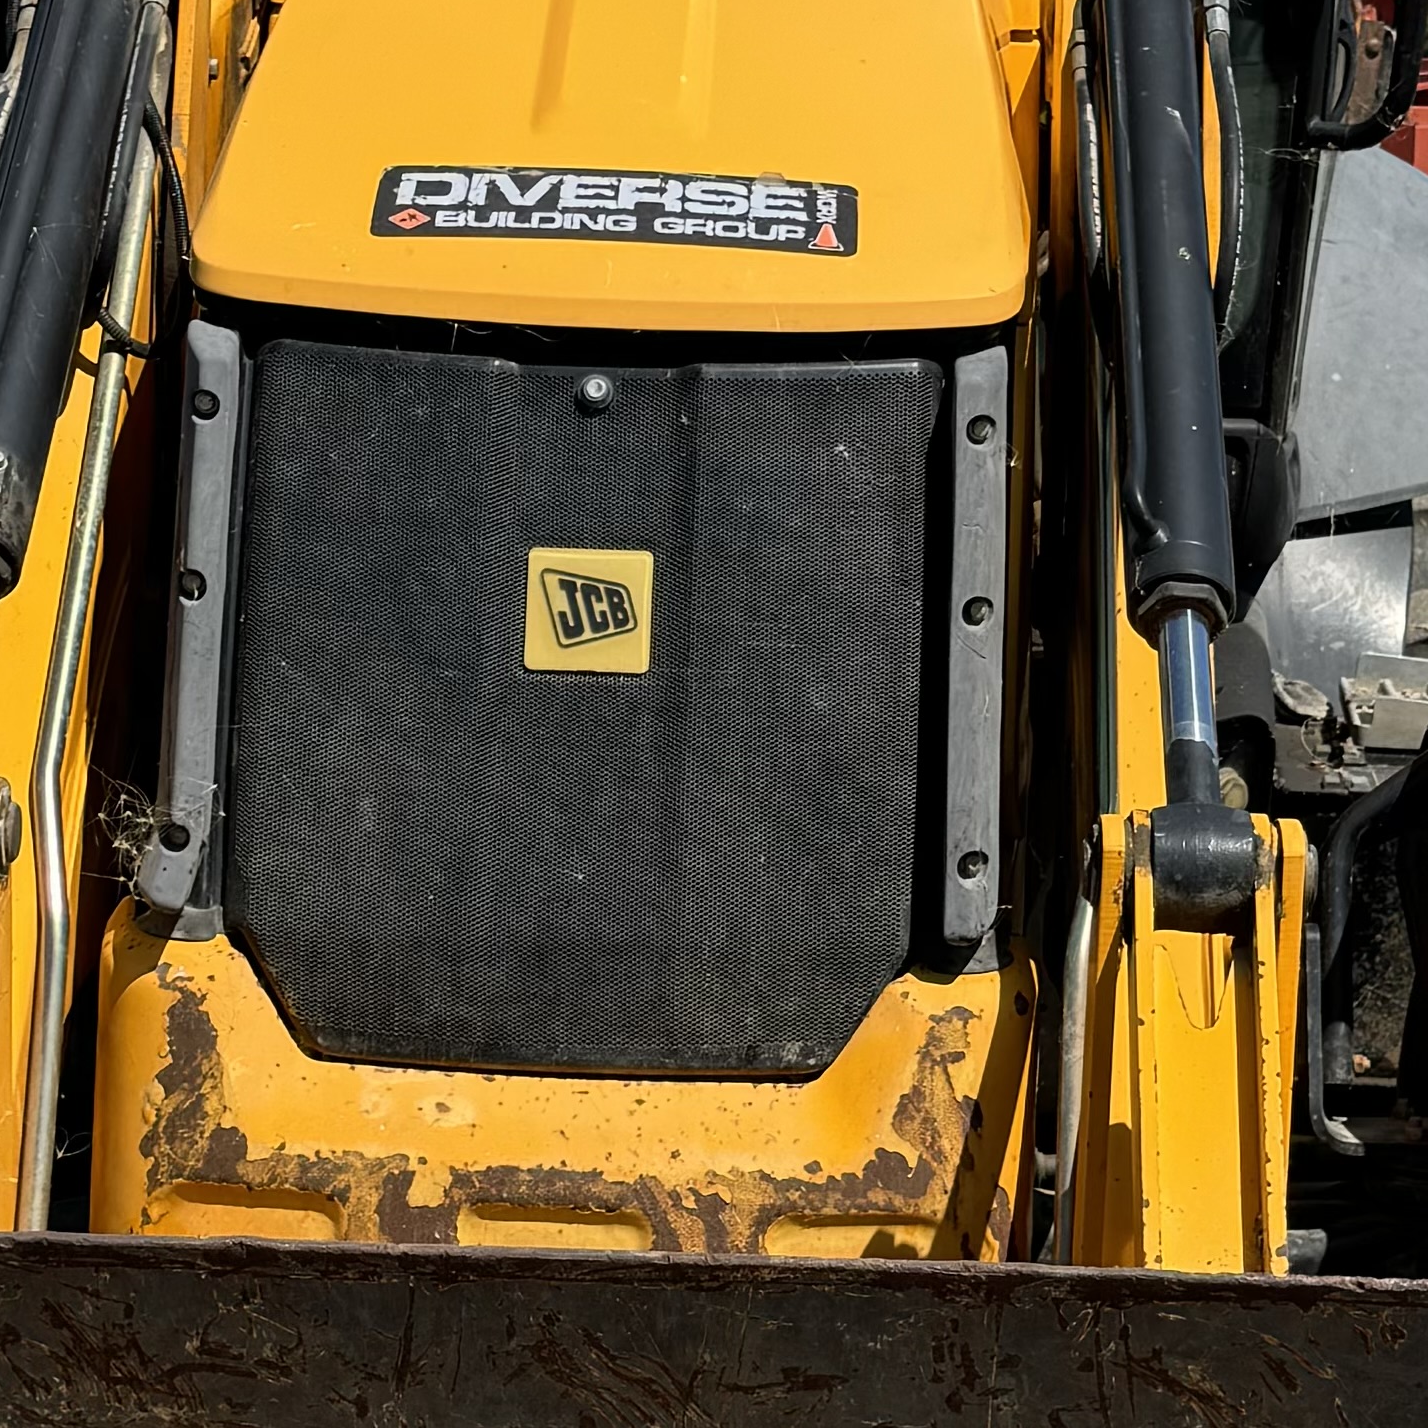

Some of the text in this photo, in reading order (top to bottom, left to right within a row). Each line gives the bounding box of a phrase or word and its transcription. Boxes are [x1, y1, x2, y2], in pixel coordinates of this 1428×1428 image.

[394, 172, 808, 223] DIVERSE
[434, 209, 807, 242] BUILDING GROUP
[557, 577, 631, 640] JCB
